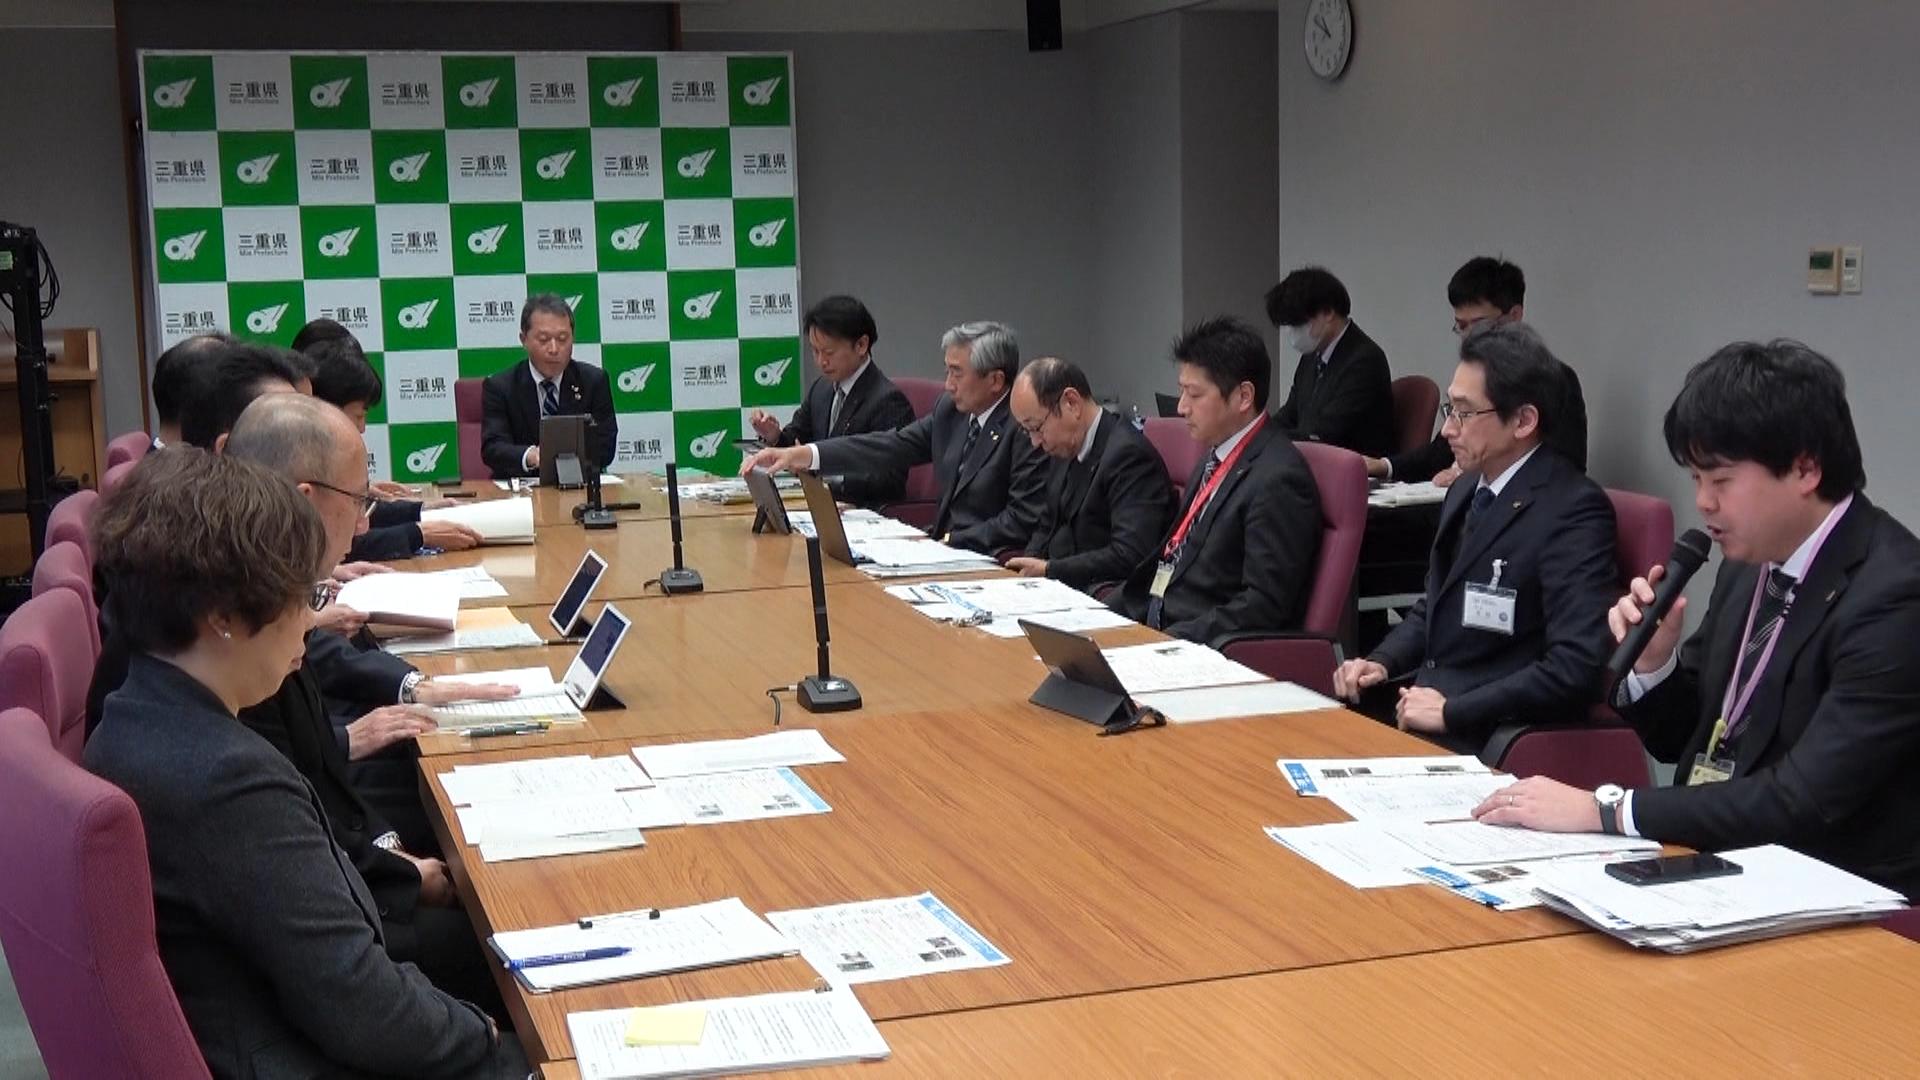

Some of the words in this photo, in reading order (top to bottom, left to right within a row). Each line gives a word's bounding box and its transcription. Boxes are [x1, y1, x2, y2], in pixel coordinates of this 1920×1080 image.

[229, 81, 278, 97] 三重県
[382, 83, 430, 98] 三重県
[529, 82, 575, 97] 三重県
[672, 81, 715, 97] 三重県
[155, 160, 205, 177] 三重県
[311, 159, 359, 174] 三重県
[461, 155, 506, 170] 三重県
[604, 155, 649, 170] 三重県
[743, 154, 786, 169] 三重県
[391, 231, 438, 247] 三重県
[538, 229, 582, 243] 三重県
[678, 225, 721, 240] 三重県
[239, 233, 288, 249] 三重県
[468, 302, 514, 316] 三重県
[611, 299, 655, 314] 三重県
[750, 294, 792, 309] 三重県
[166, 312, 215, 328] 三重県
[320, 307, 368, 321] 三重県
[683, 365, 726, 379] 三重県
[400, 378, 446, 393] 三重県
[618, 440, 661, 455] 三重県
